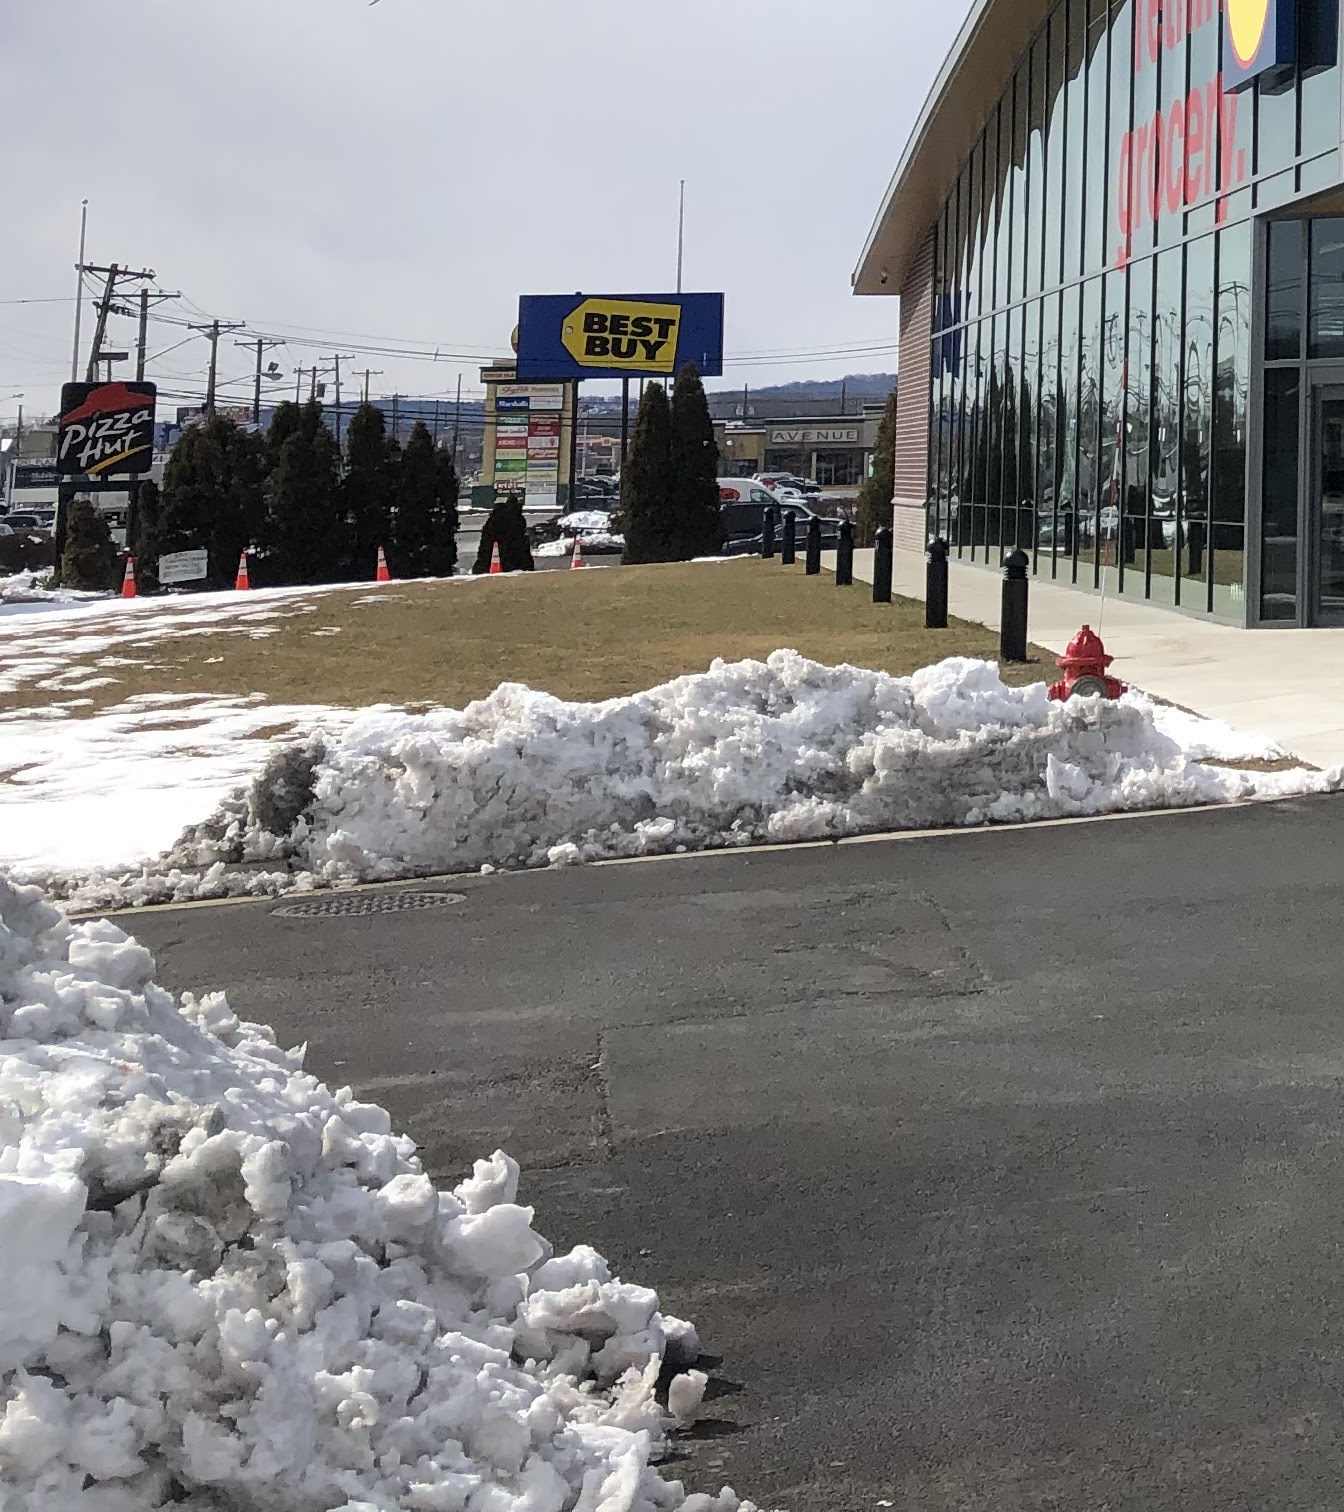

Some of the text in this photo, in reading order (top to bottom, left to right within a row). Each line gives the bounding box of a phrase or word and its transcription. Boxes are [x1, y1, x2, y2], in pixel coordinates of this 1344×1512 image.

[1115, 71, 1245, 274] grocery.
[583, 313, 677, 339] BEST
[584, 335, 668, 361] BUY
[60, 409, 153, 460] Pizza
[76, 430, 143, 468] Hut
[773, 430, 857, 441] AVENUE
